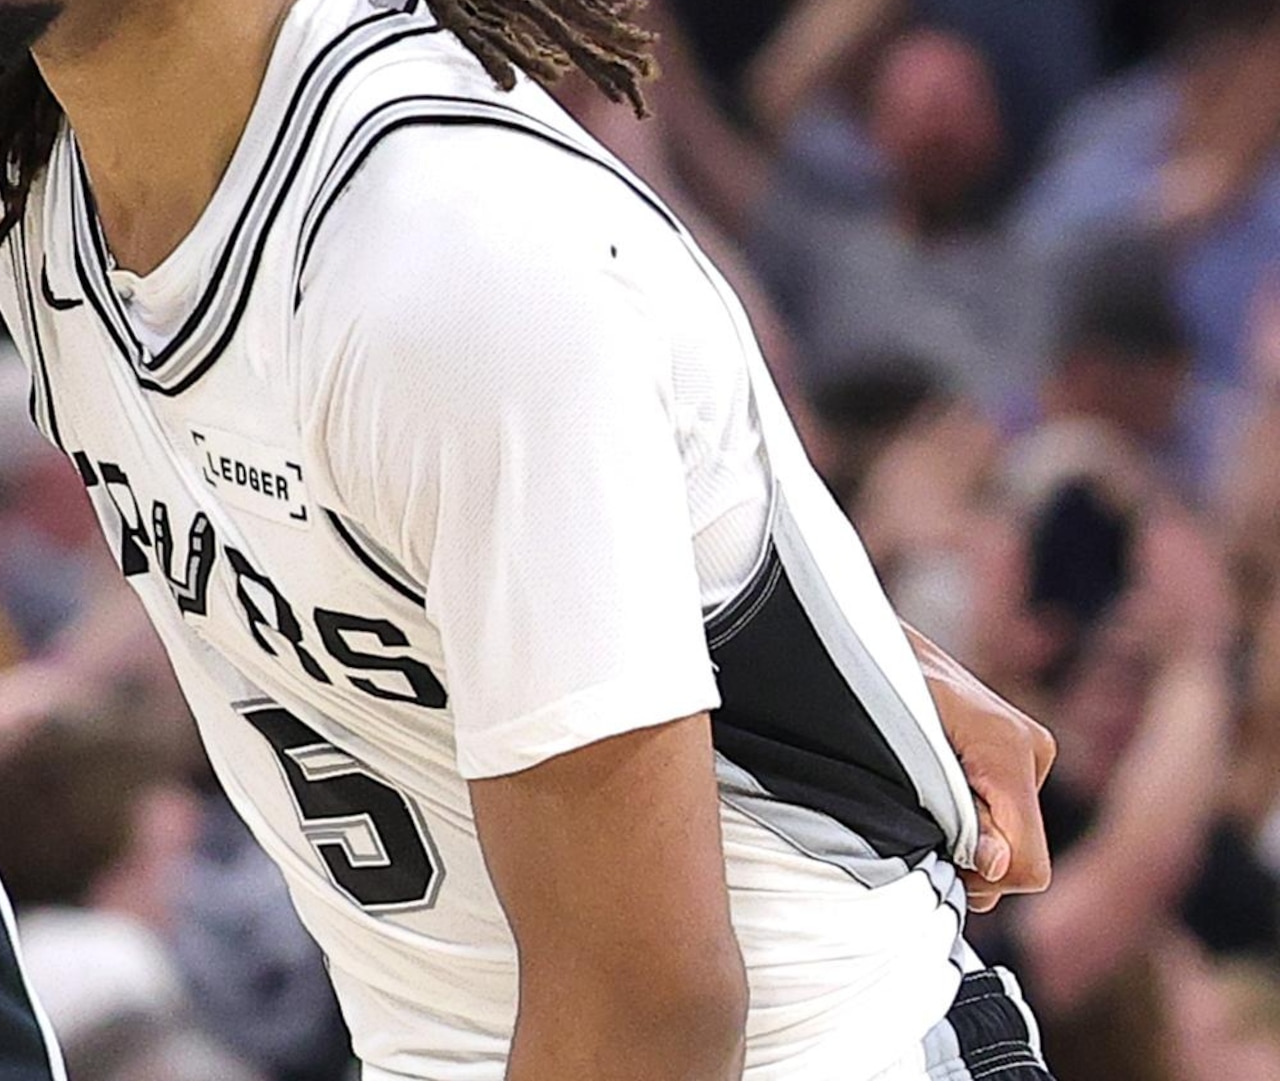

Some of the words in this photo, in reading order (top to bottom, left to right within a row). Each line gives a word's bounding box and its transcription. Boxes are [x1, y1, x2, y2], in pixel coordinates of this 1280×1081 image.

[73, 451, 448, 709] PURS
[207, 452, 289, 502] LEDGER
[231, 698, 446, 914] 5
